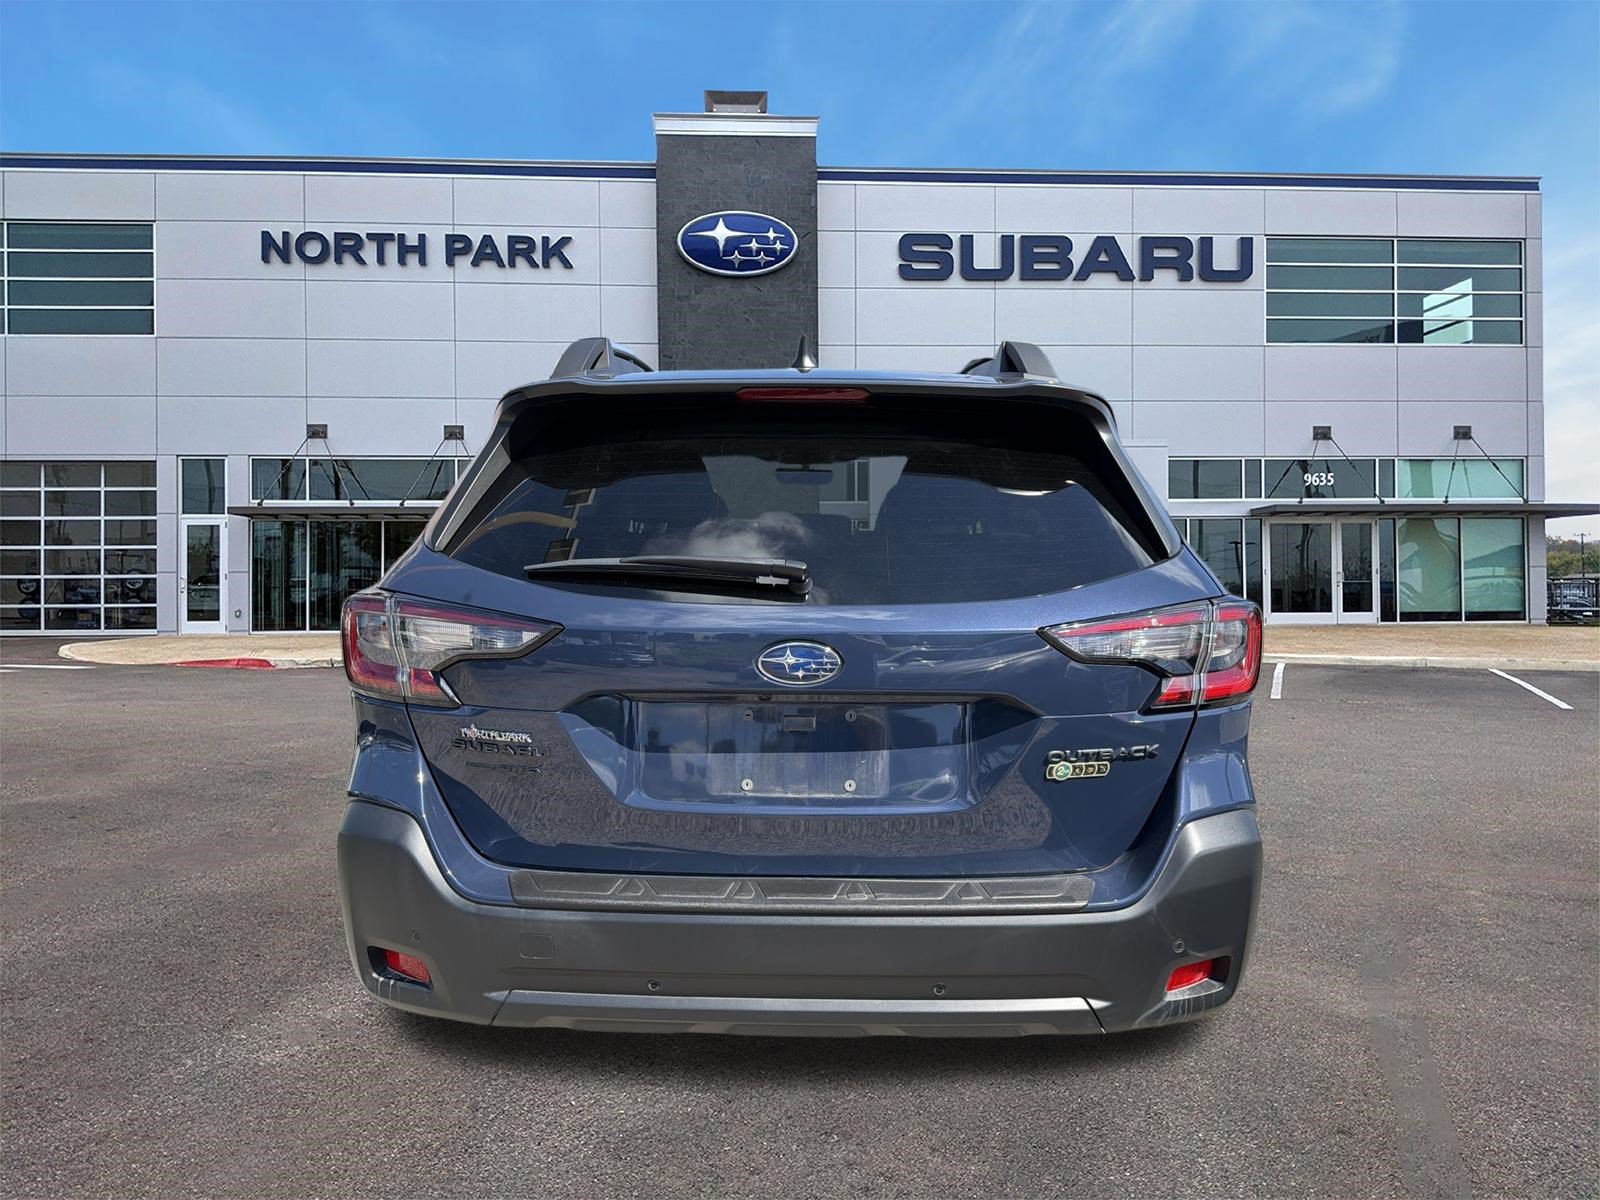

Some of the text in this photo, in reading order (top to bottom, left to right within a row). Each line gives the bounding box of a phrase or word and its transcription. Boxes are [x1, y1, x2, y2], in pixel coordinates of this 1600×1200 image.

[260, 230, 574, 269] NORTH PARK
[898, 233, 1254, 282] SUBARU
[1303, 472, 1335, 487] 9635
[1047, 743, 1160, 762] OUTBACK
